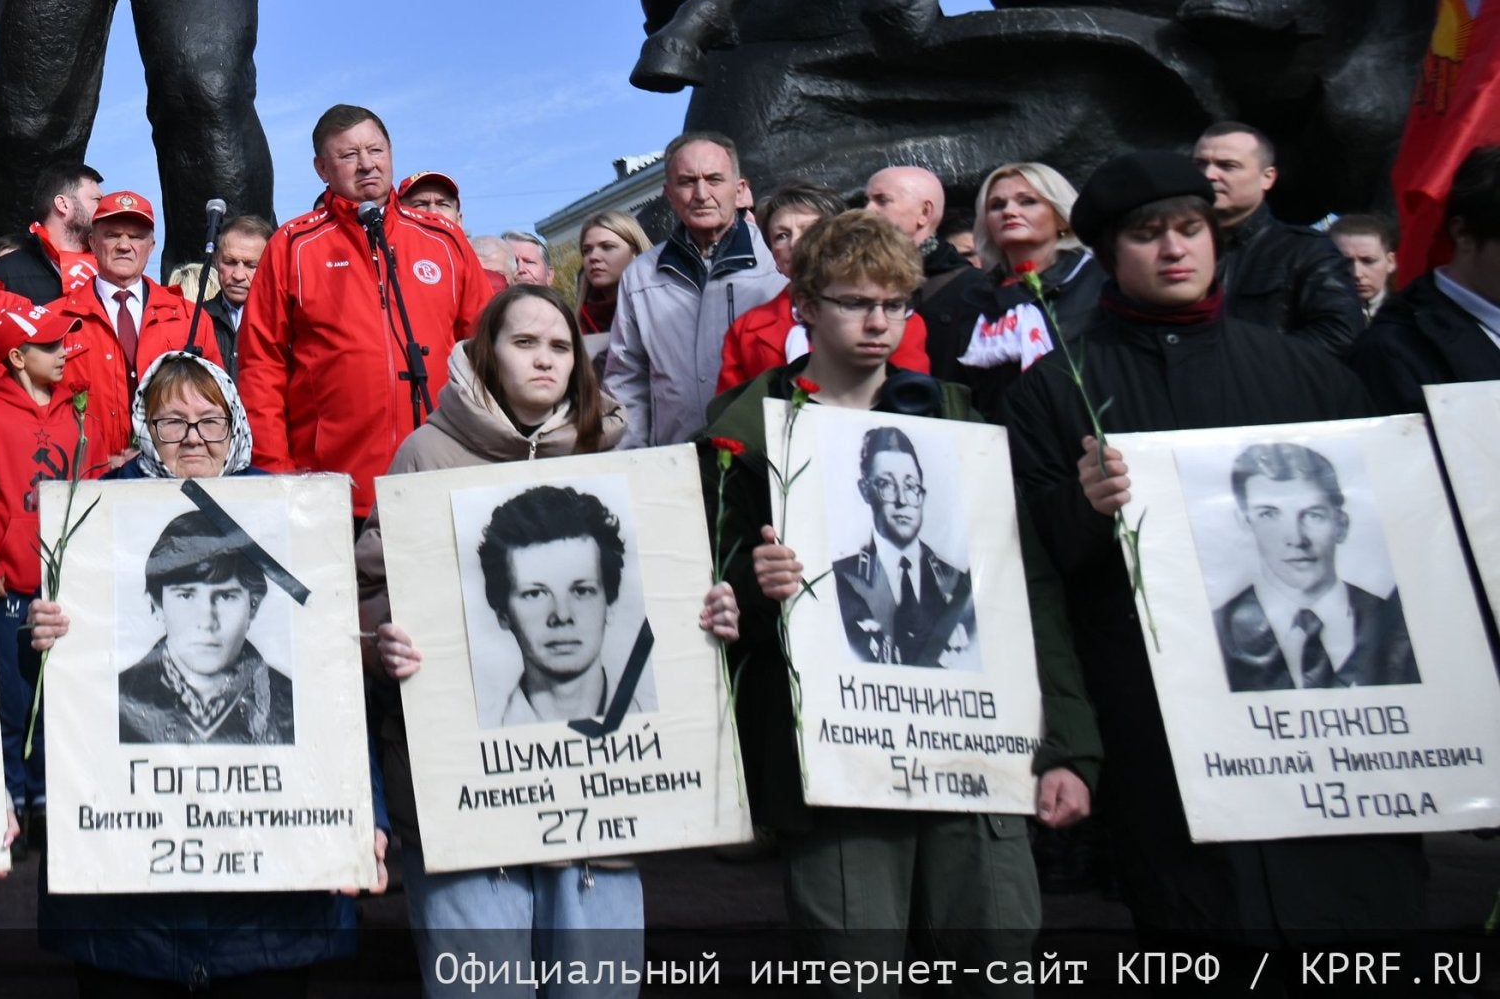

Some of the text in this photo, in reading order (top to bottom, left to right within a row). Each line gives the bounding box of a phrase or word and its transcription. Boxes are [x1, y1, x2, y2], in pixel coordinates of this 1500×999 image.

[839, 675, 996, 720] КЛЮЧНИКОВ
[819, 718, 895, 750] ЛЕОНИД
[1248, 706, 1409, 740] ЧЕЛЯКОВ
[130, 759, 282, 795] ГОГОЛЕВ
[890, 756, 989, 798] 54 ГОДА
[1204, 747, 1483, 777] НИКОЛАЙ НИКОЛАЕВИЧ
[580, 771, 701, 799] ЮРЬЕВИЧ
[1301, 782, 1438, 818] 43 ГОДА
[79, 803, 353, 830] ВИКТОР ВАЛЕНТИНОВИЧ
[538, 808, 637, 845] 27 ЛЕТ
[150, 838, 263, 874] 26 ЛЕТ
